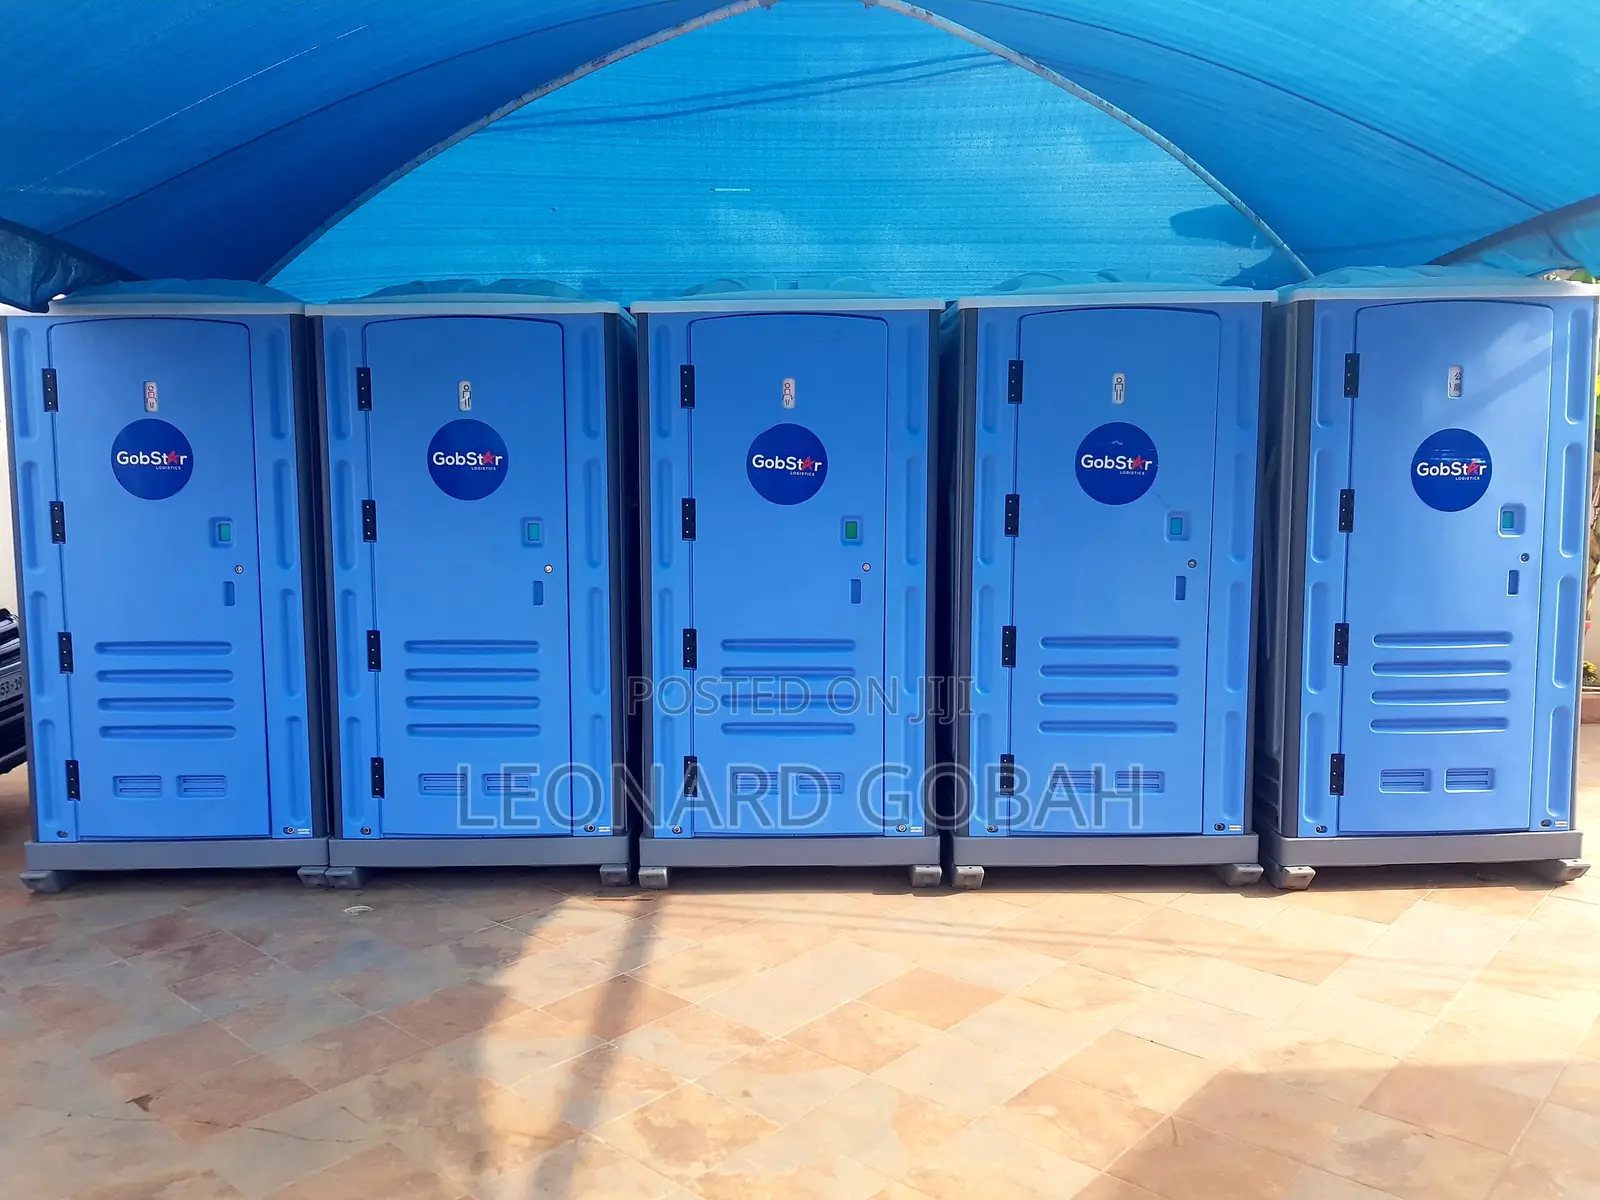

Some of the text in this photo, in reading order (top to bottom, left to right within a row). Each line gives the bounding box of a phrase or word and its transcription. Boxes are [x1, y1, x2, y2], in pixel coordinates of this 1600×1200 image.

[116, 451, 188, 465] GobStar
[432, 450, 503, 466] GobStar
[752, 454, 823, 471] GobStar
[1081, 454, 1153, 470] GobStar
[1416, 460, 1487, 477] GobStar
